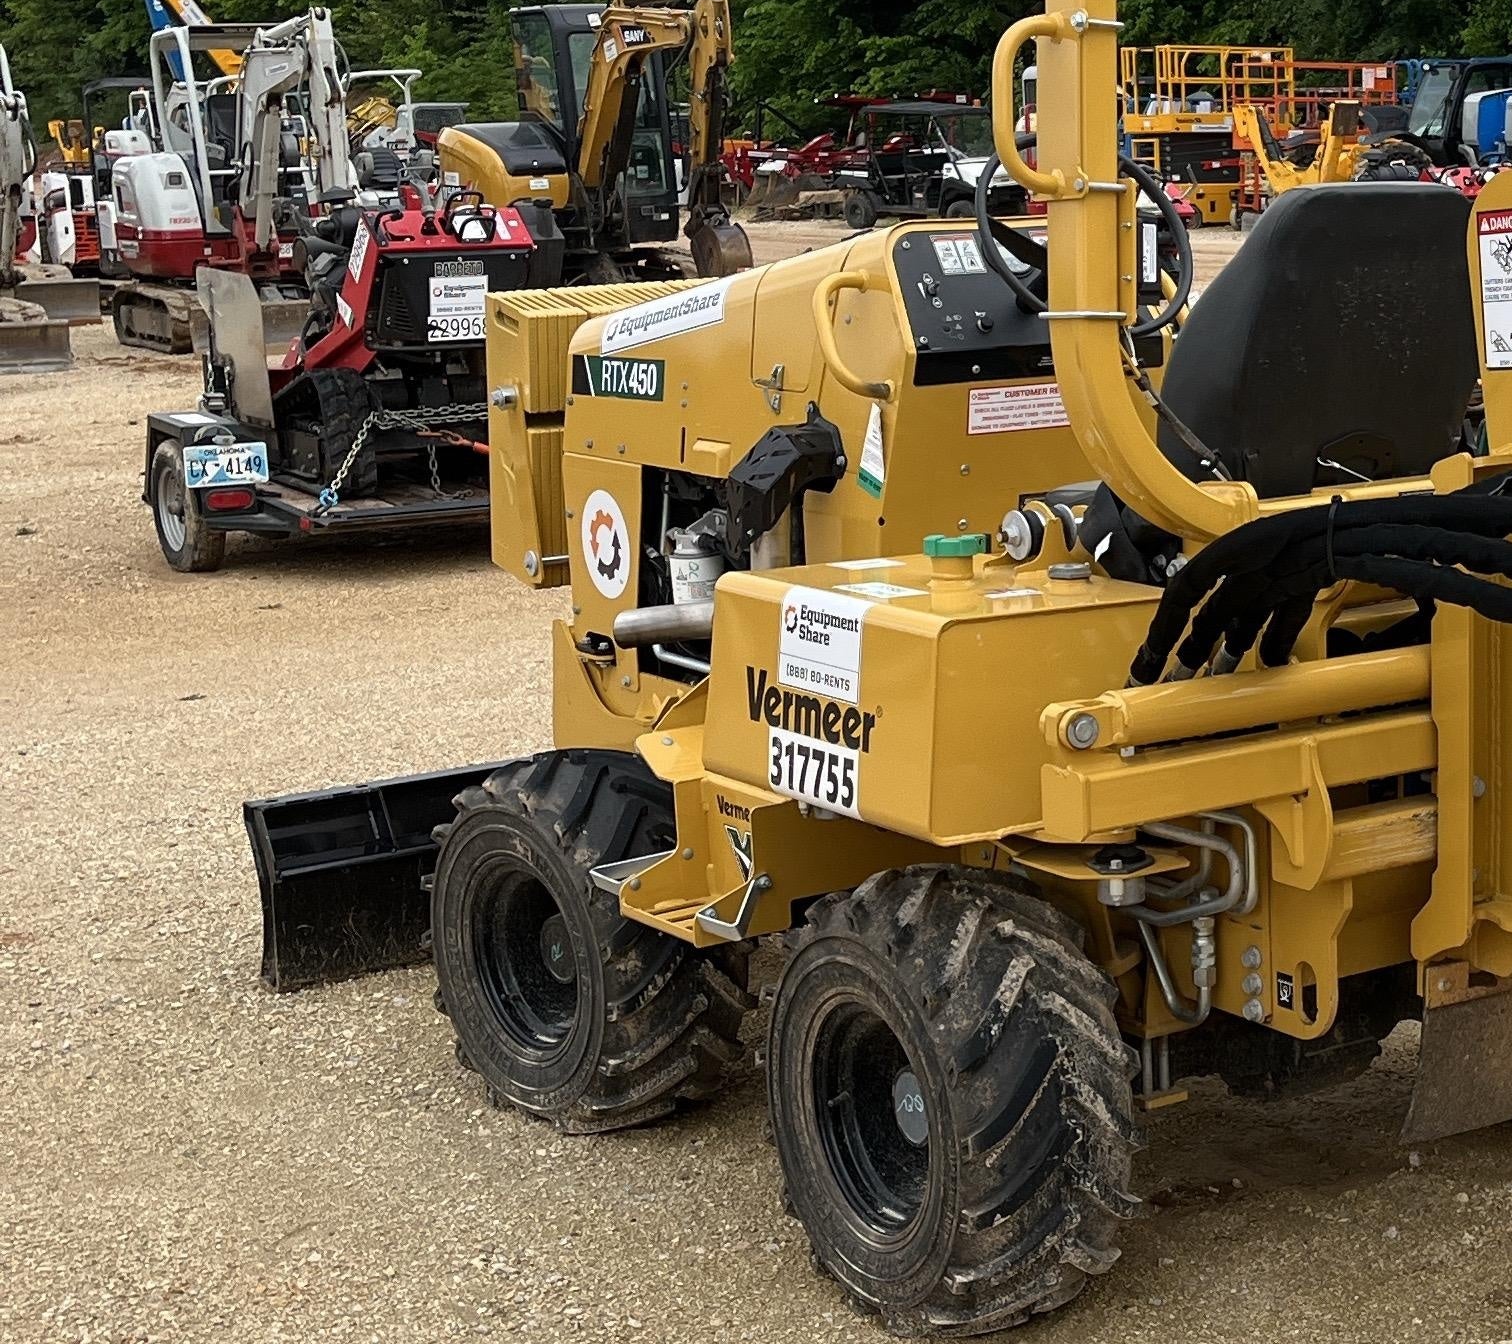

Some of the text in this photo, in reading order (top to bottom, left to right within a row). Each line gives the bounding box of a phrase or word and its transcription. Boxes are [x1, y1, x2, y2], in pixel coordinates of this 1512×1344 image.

[623, 29, 646, 43] SANY
[434, 260, 484, 277] BARRETO
[618, 292, 721, 336] EquipmentShare
[601, 360, 658, 396] RTX450
[1004, 387, 1048, 399] CUSTOMER
[800, 605, 859, 633] Equipment
[799, 624, 831, 646] Share
[786, 662, 851, 692] (888) 80-RENTS
[746, 665, 876, 754] Vermeer
[770, 736, 855, 809] 317755
